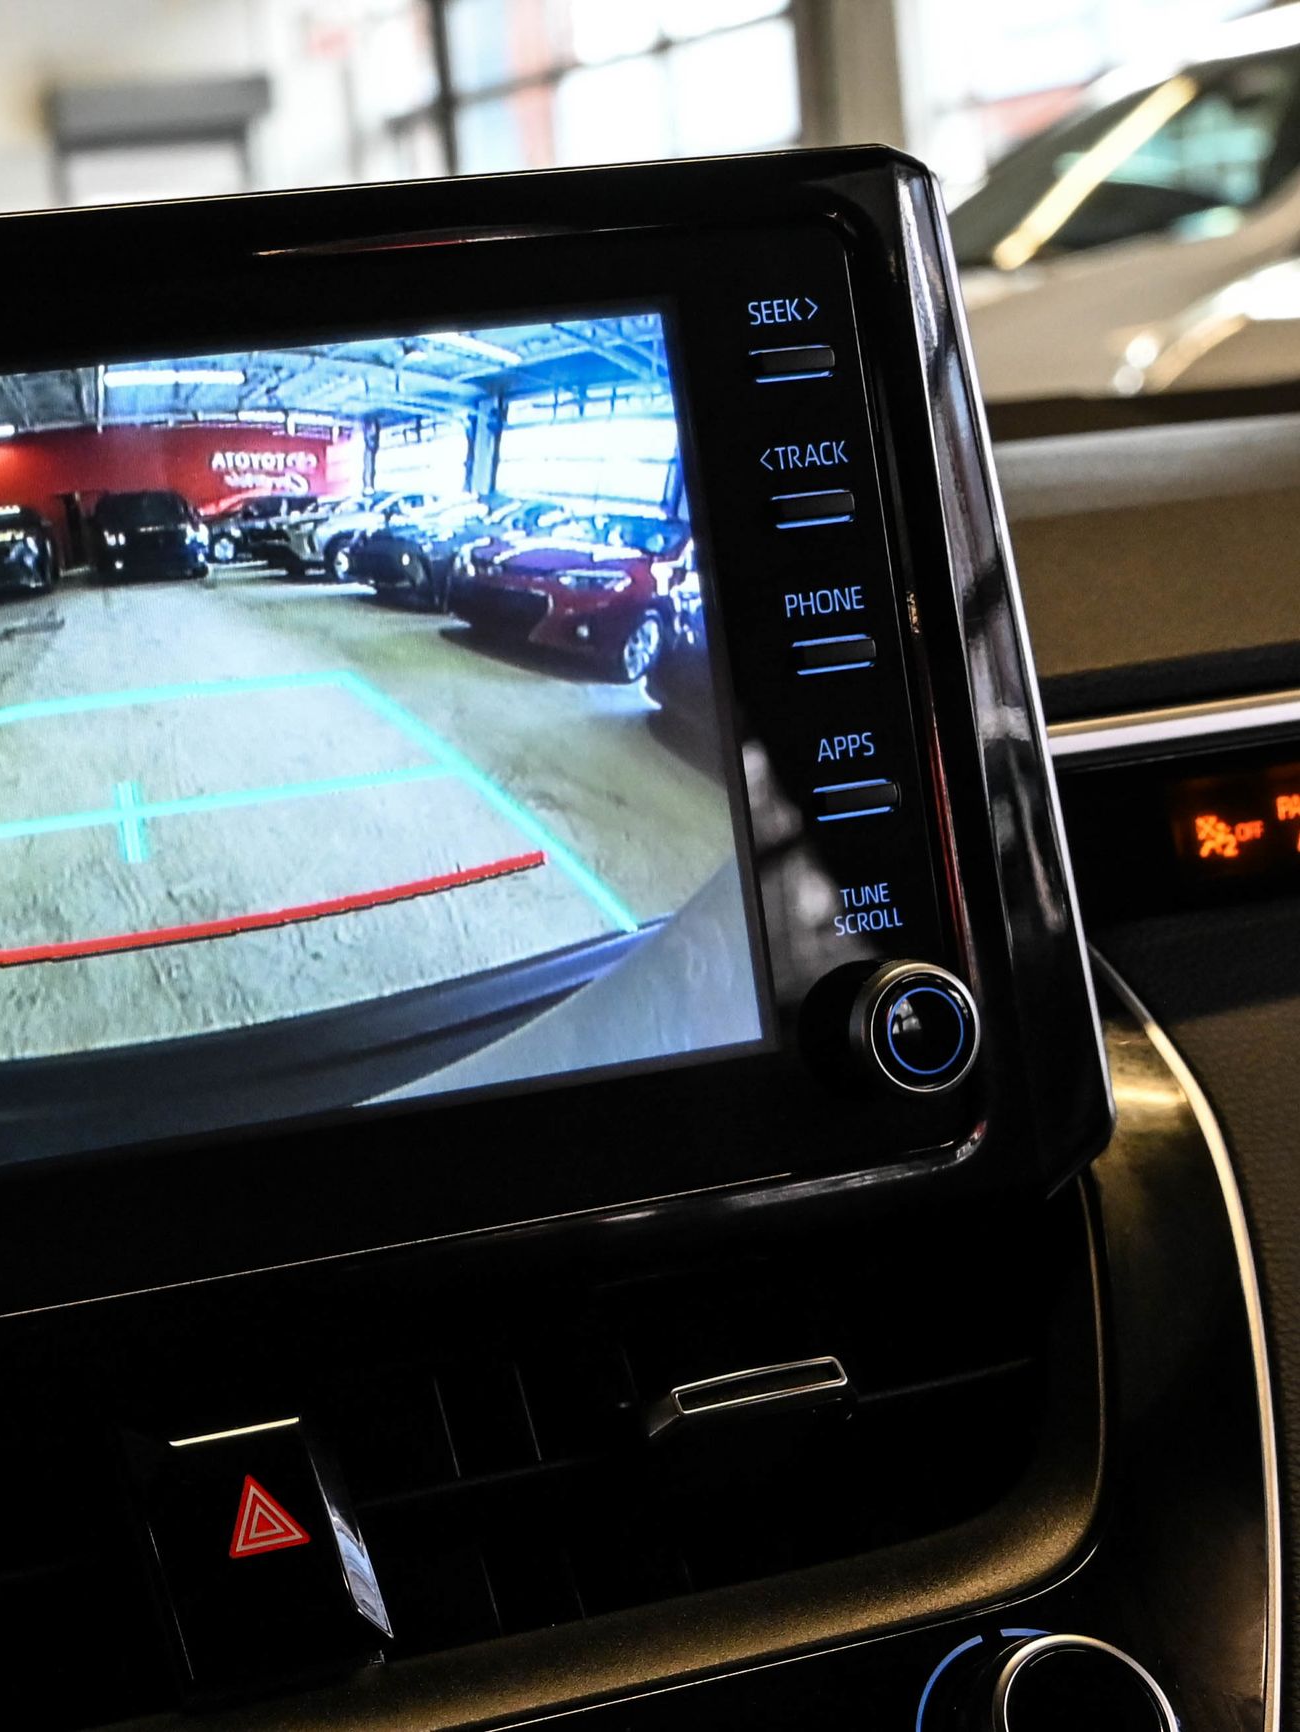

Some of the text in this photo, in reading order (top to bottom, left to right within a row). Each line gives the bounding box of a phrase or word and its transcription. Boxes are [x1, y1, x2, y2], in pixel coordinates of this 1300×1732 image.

[784, 586, 865, 618] PHONE
[817, 732, 875, 762] APPS
[839, 882, 891, 908] TUNE
[833, 907, 903, 937] SCROLL
